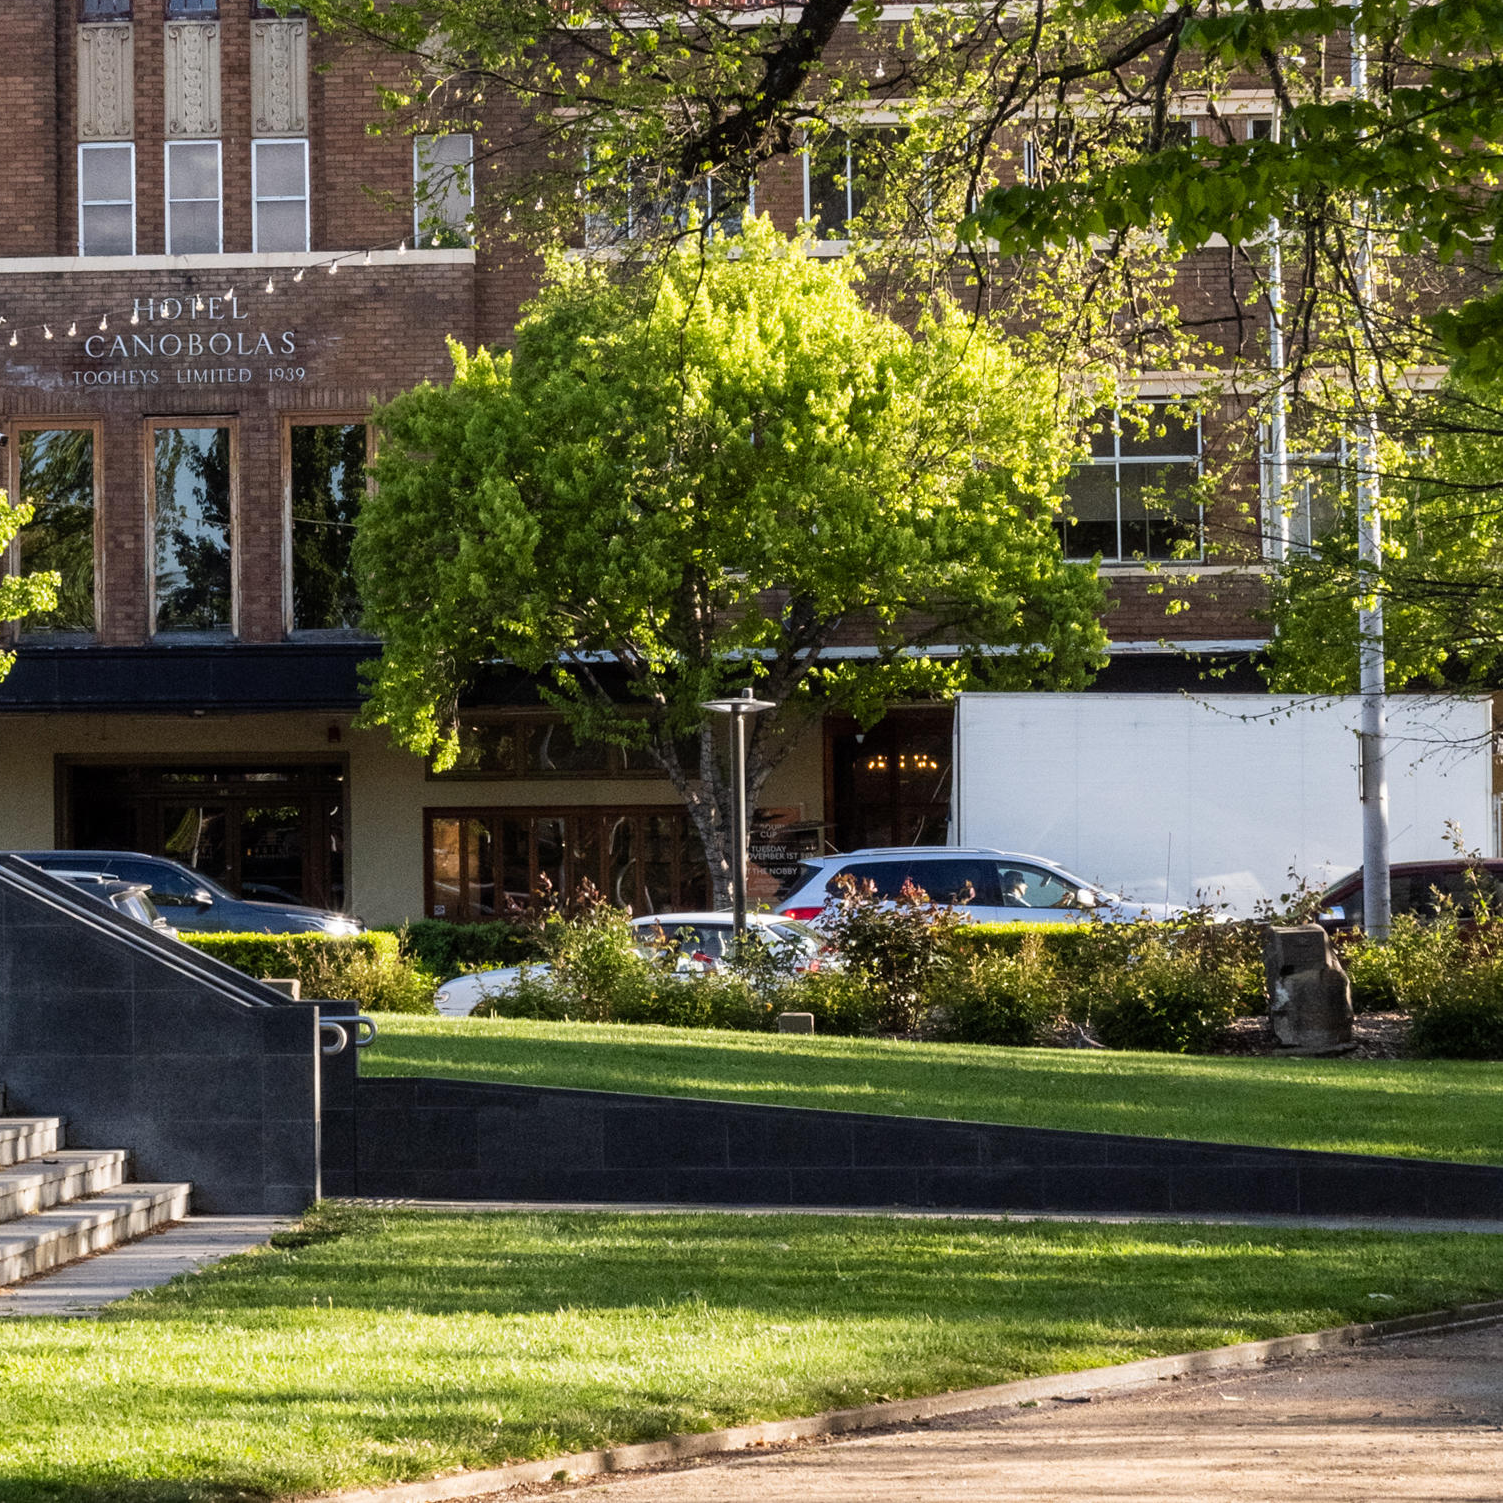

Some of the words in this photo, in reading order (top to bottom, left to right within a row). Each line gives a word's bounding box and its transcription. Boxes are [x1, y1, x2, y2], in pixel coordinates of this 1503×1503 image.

[133, 297, 249, 321] HOTEL
[84, 331, 297, 359] CANOBOLAS
[72, 369, 159, 386] TOOHEYS
[176, 368, 252, 385] LIMITED
[268, 367, 306, 383] 1939
[786, 852, 798, 860] 1ST
